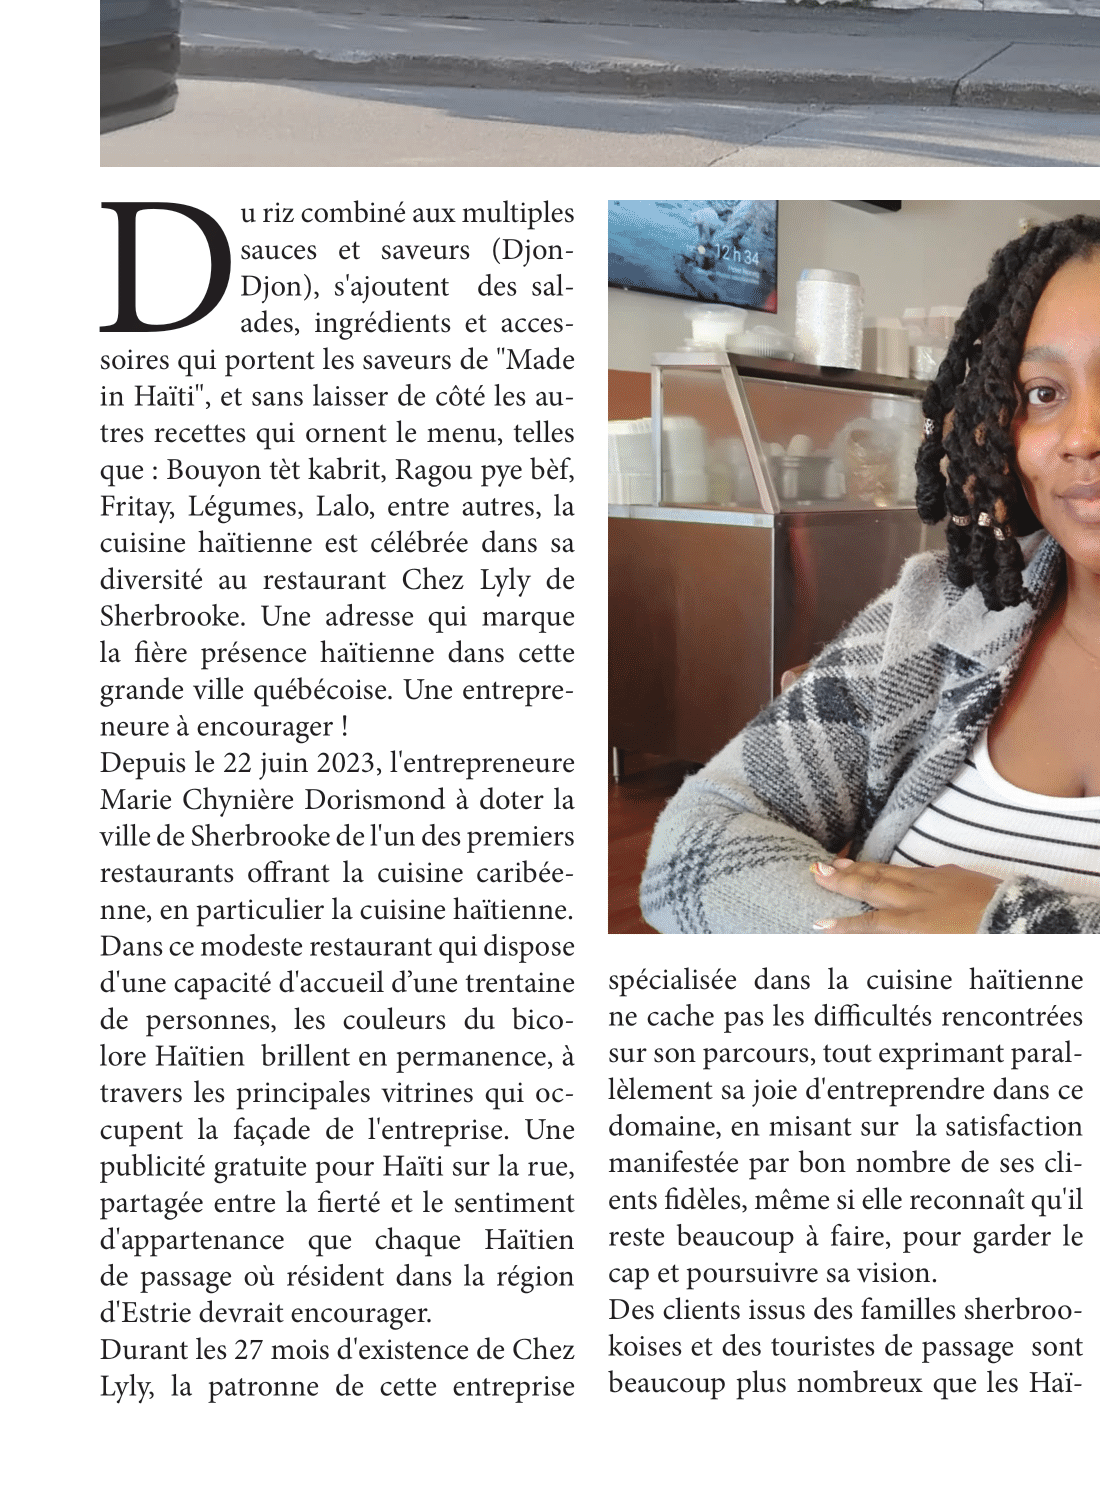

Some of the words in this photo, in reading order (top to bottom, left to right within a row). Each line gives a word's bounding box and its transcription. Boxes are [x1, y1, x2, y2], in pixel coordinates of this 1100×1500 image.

[714, 243, 730, 260] 12
[744, 249, 759, 266] 34
[101, 350, 169, 369] soires
[178, 349, 216, 376] qui
[225, 352, 315, 376] portent
[323, 347, 354, 369] les
[363, 355, 451, 369] saveurs
[461, 347, 488, 369] de
[497, 347, 574, 369] "Made
[101, 496, 174, 523] Fritay,
[189, 495, 303, 523] Légumes,
[317, 494, 374, 519] Lalo,
[388, 498, 449, 516] entre
[463, 498, 541, 519] autres,
[554, 494, 574, 516] la
[100, 752, 185, 779] Depuis
[195, 750, 214, 772] le
[224, 753, 251, 772] 22
[259, 753, 308, 780] juin
[317, 753, 381, 776] 2023,
[390, 750, 574, 779] l'entrepreneure
[100, 789, 171, 809] Marie
[183, 787, 293, 817] Chynière
[305, 787, 445, 809] Dorismond
[457, 788, 469, 809] à
[480, 787, 543, 809] doter
[554, 787, 575, 809] la
[609, 967, 736, 996] spécialisée
[755, 967, 810, 989] dans
[828, 967, 849, 989] la
[867, 969, 952, 989] cuisine
[970, 967, 1083, 989] haïtienne
[608, 1077, 713, 1099] lèlement
[722, 1085, 745, 1099] sa
[752, 1080, 797, 1107] joie
[806, 1077, 984, 1106] d'entreprendre
[994, 1077, 1049, 1099] dans
[1059, 1085, 1083, 1099] ce
[101, 1227, 284, 1256] d'appartenance
[309, 1235, 351, 1256] que
[376, 1227, 460, 1256] chaque
[485, 1229, 574, 1249] Haïtien
[609, 1228, 664, 1246] reste
[677, 1224, 793, 1253] beaucoup
[807, 1225, 818, 1246] à
[831, 1224, 890, 1249] faire,
[903, 1232, 961, 1253] pour
[973, 1224, 1051, 1253] garder
[1063, 1224, 1083, 1246] le
[100, 1339, 188, 1359] Durant
[196, 1337, 226, 1359] les
[235, 1340, 263, 1359] 27
[271, 1339, 329, 1359] mois
[338, 1337, 468, 1359] d'existence
[477, 1337, 504, 1359] de
[513, 1337, 575, 1360] Chez
